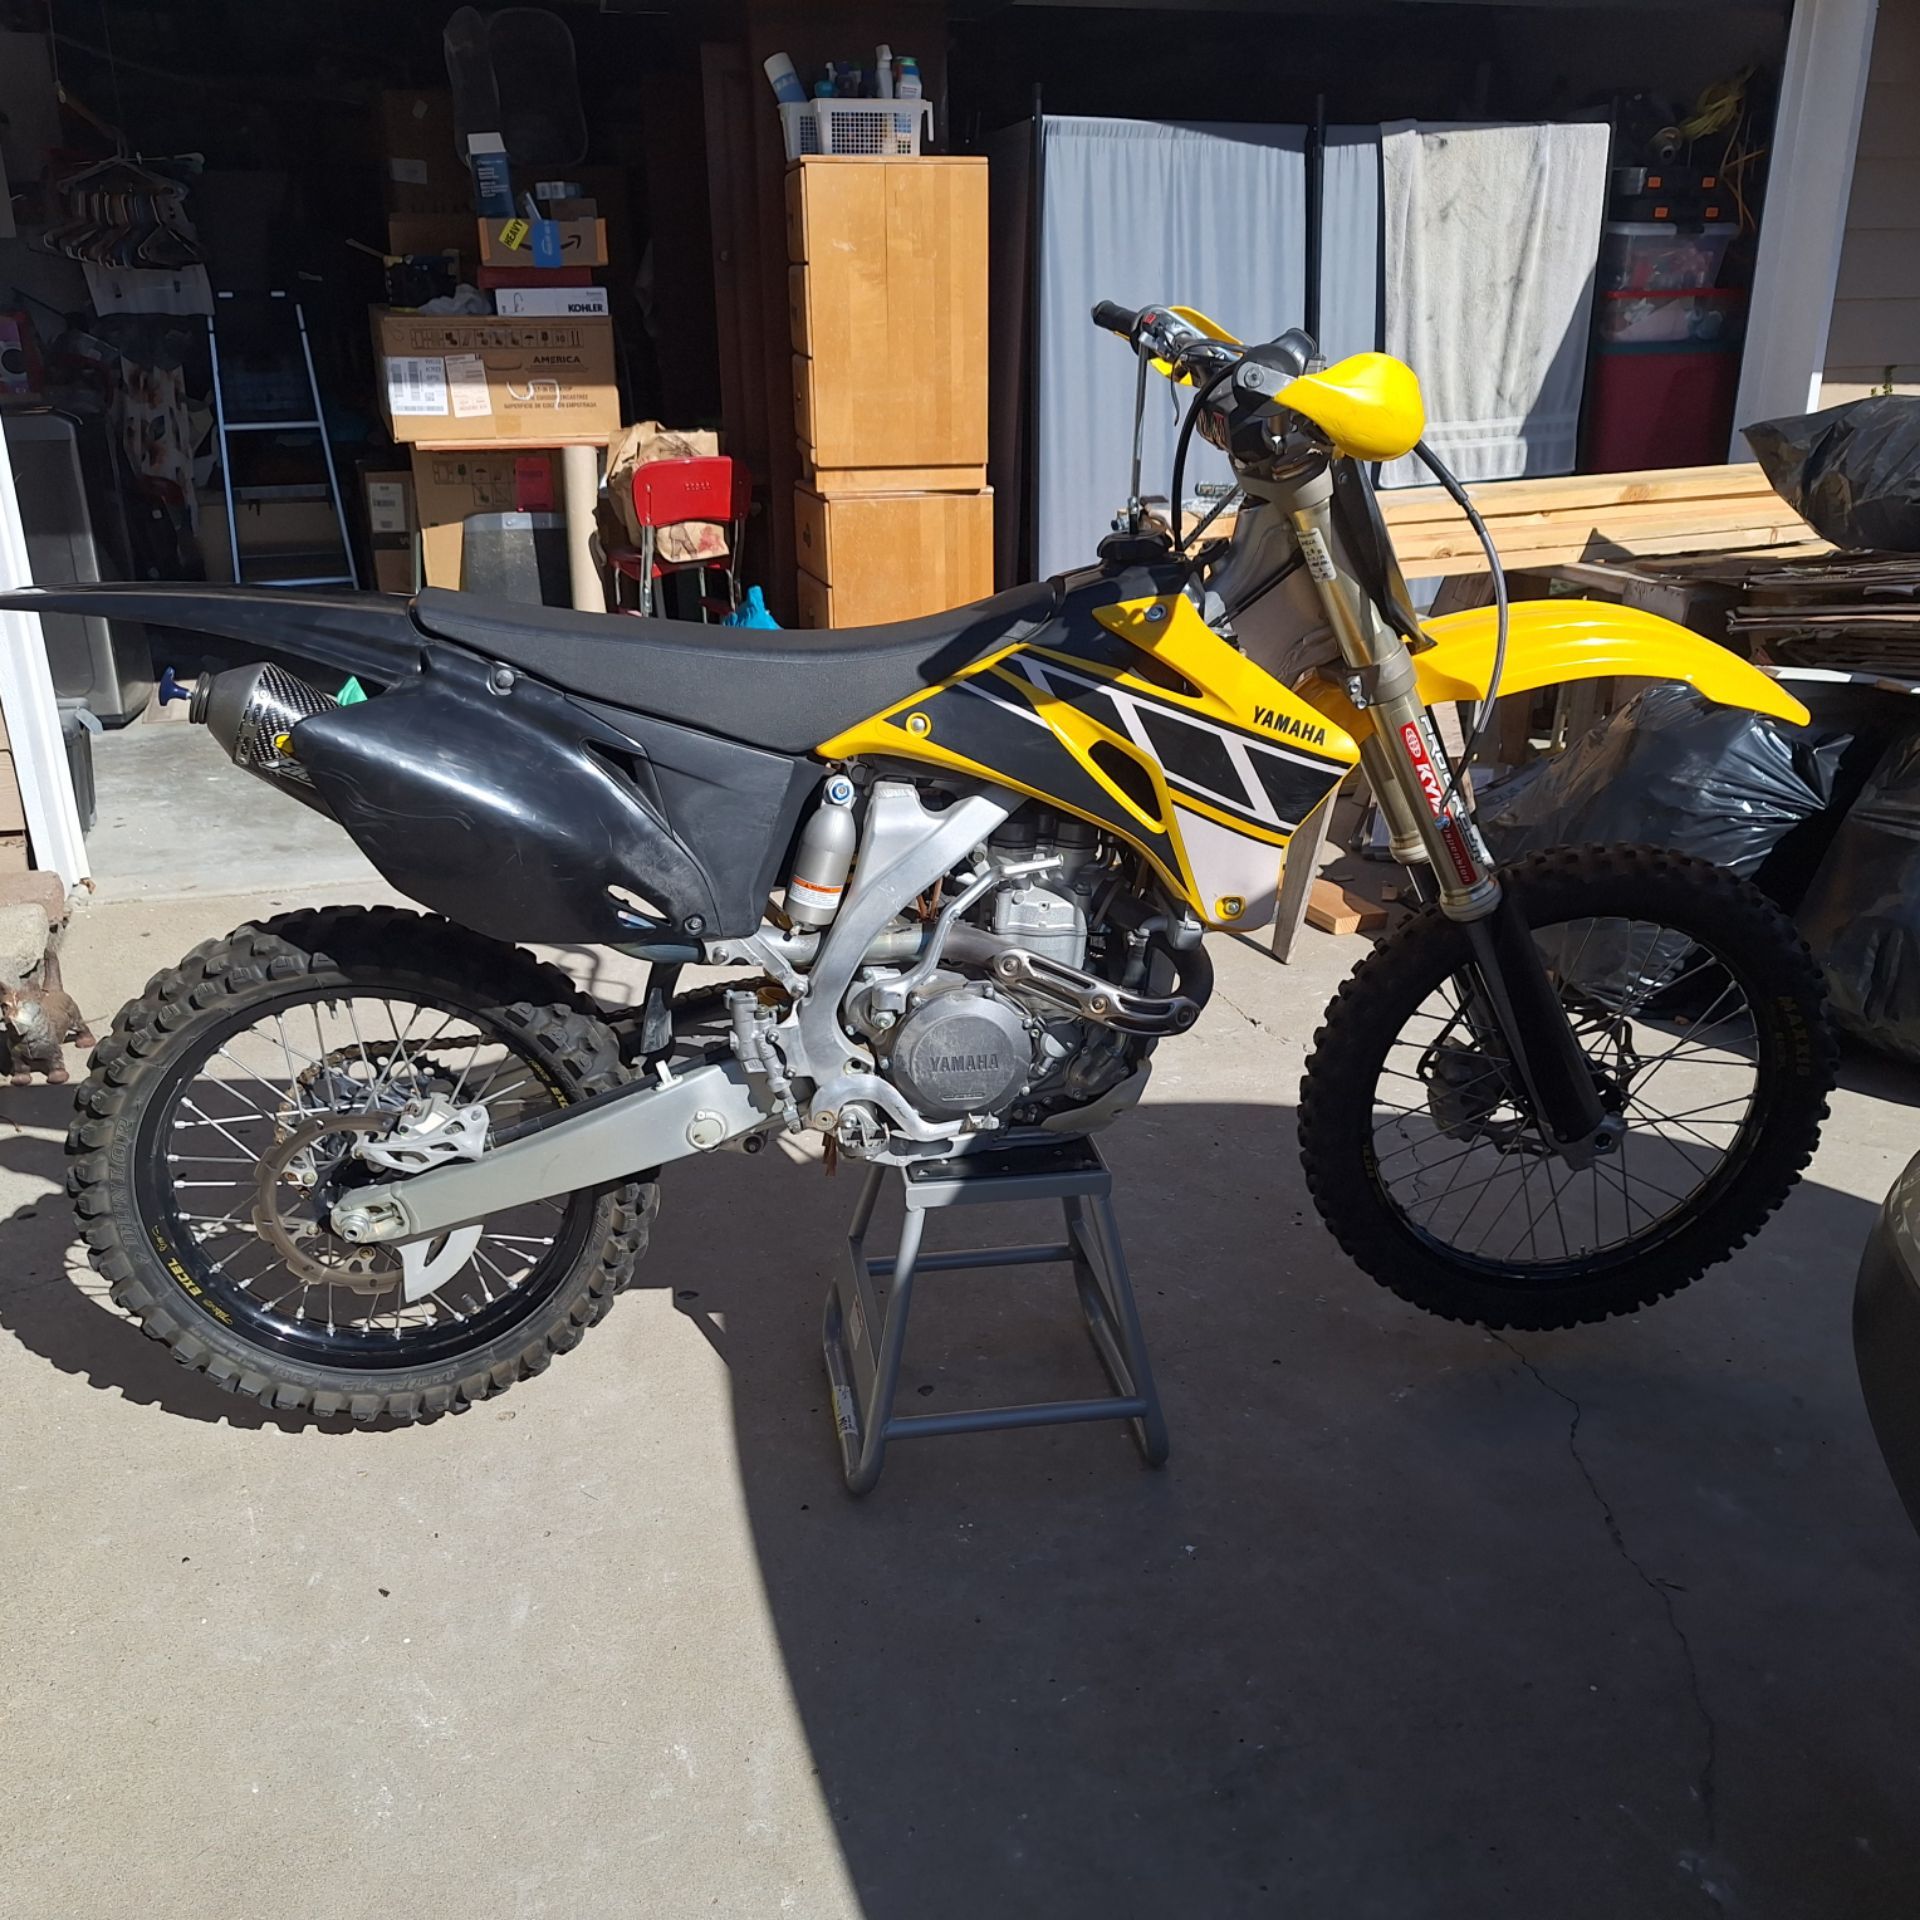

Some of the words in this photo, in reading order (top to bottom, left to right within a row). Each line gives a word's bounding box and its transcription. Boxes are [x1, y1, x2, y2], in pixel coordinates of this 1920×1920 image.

[503, 218, 524, 247] HEAVY
[568, 303, 603, 313] KOHLER
[533, 355, 581, 364] AMERICA
[1253, 705, 1325, 746] YAMAHA
[1419, 714, 1449, 771] PRO
[1443, 828, 1472, 883] spension
[930, 1053, 1000, 1073] YAMAHA
[550, 1086, 572, 1109] EXC
[110, 1117, 140, 1251] DUNLOP
[168, 1257, 203, 1297] EXCEL
